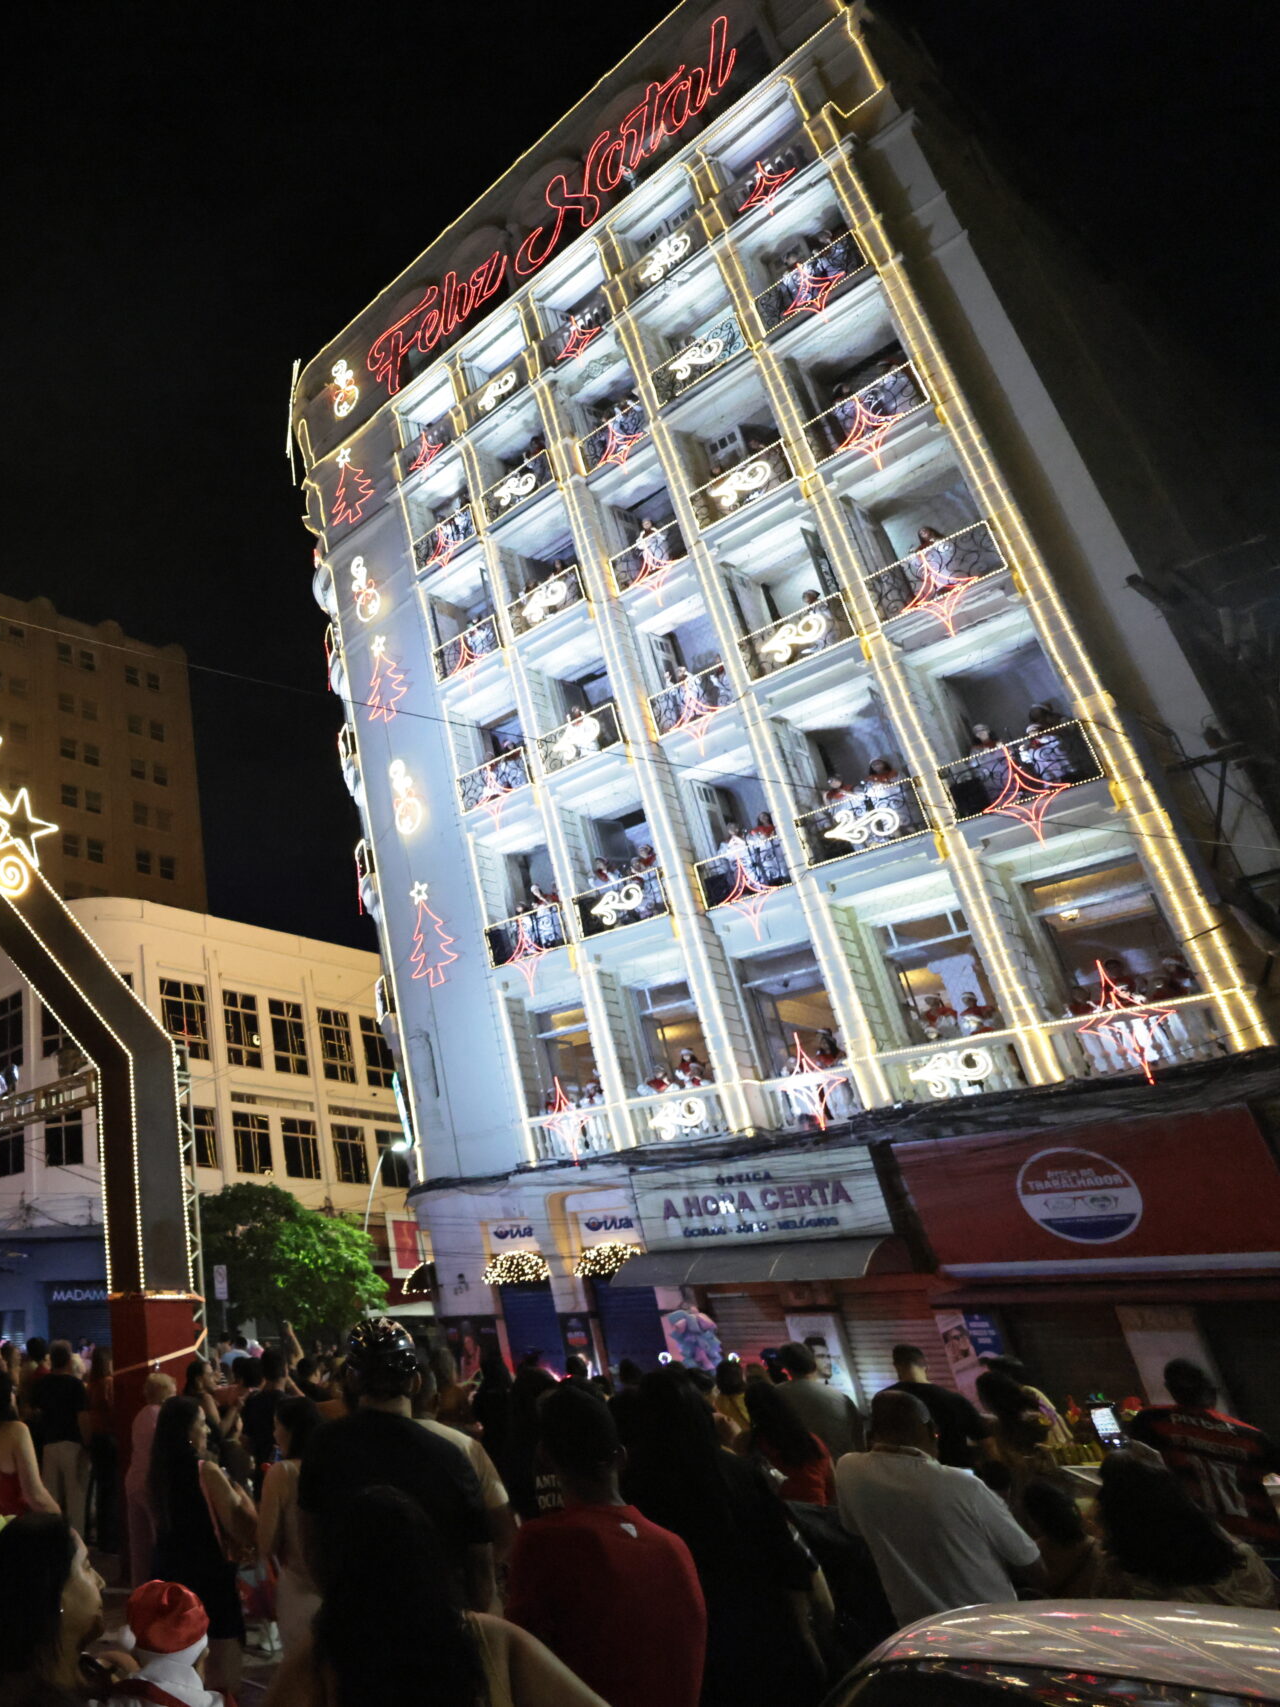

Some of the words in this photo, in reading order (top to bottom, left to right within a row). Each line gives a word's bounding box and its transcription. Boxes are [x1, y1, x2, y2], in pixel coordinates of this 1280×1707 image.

[366, 250, 509, 396] Feliz
[514, 15, 736, 276] Natal
[663, 1198, 681, 1221] A
[683, 1190, 757, 1218] HORA
[759, 1179, 854, 1212] CERTA
[1027, 1174, 1124, 1192] TRABALHADOR
